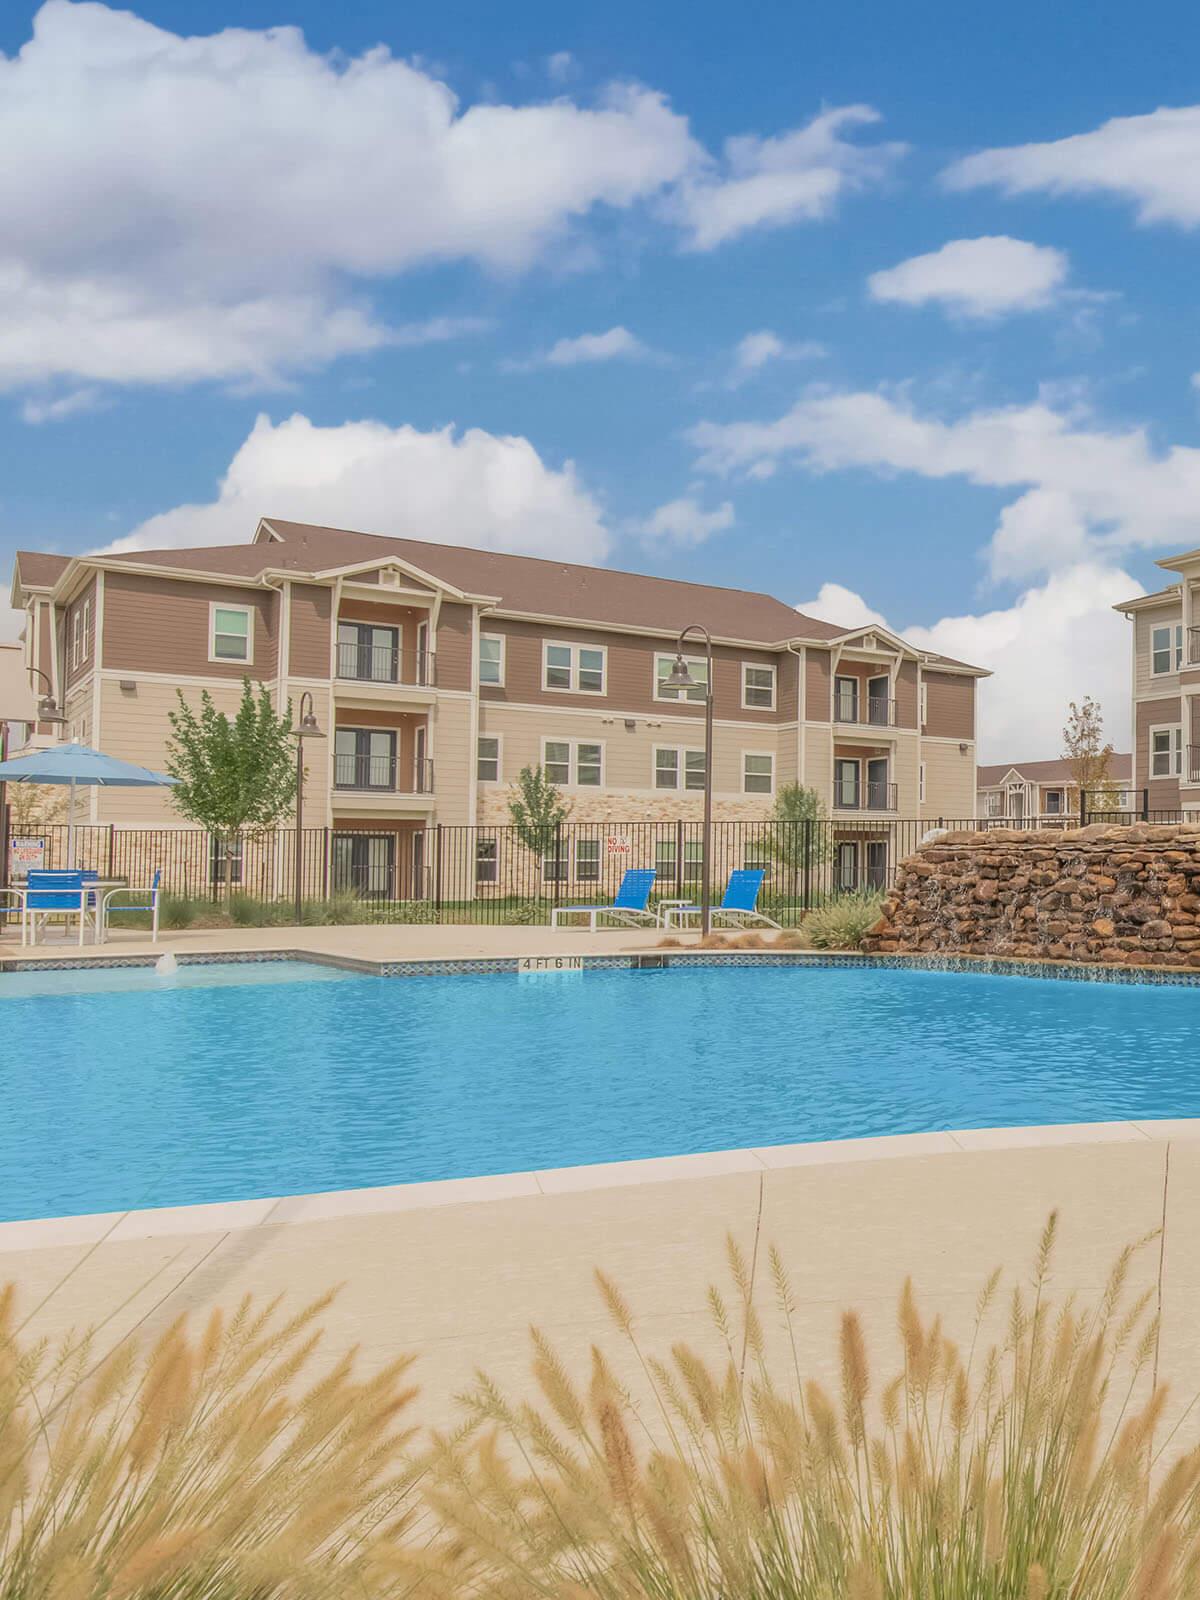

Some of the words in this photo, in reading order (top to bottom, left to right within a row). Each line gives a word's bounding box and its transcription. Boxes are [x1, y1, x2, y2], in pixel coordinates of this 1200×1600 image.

[608, 837, 616, 845] NO
[523, 959, 530, 969] 4
[537, 959, 549, 969] FT
[555, 958, 563, 969] 6
[569, 957, 581, 968] IN
